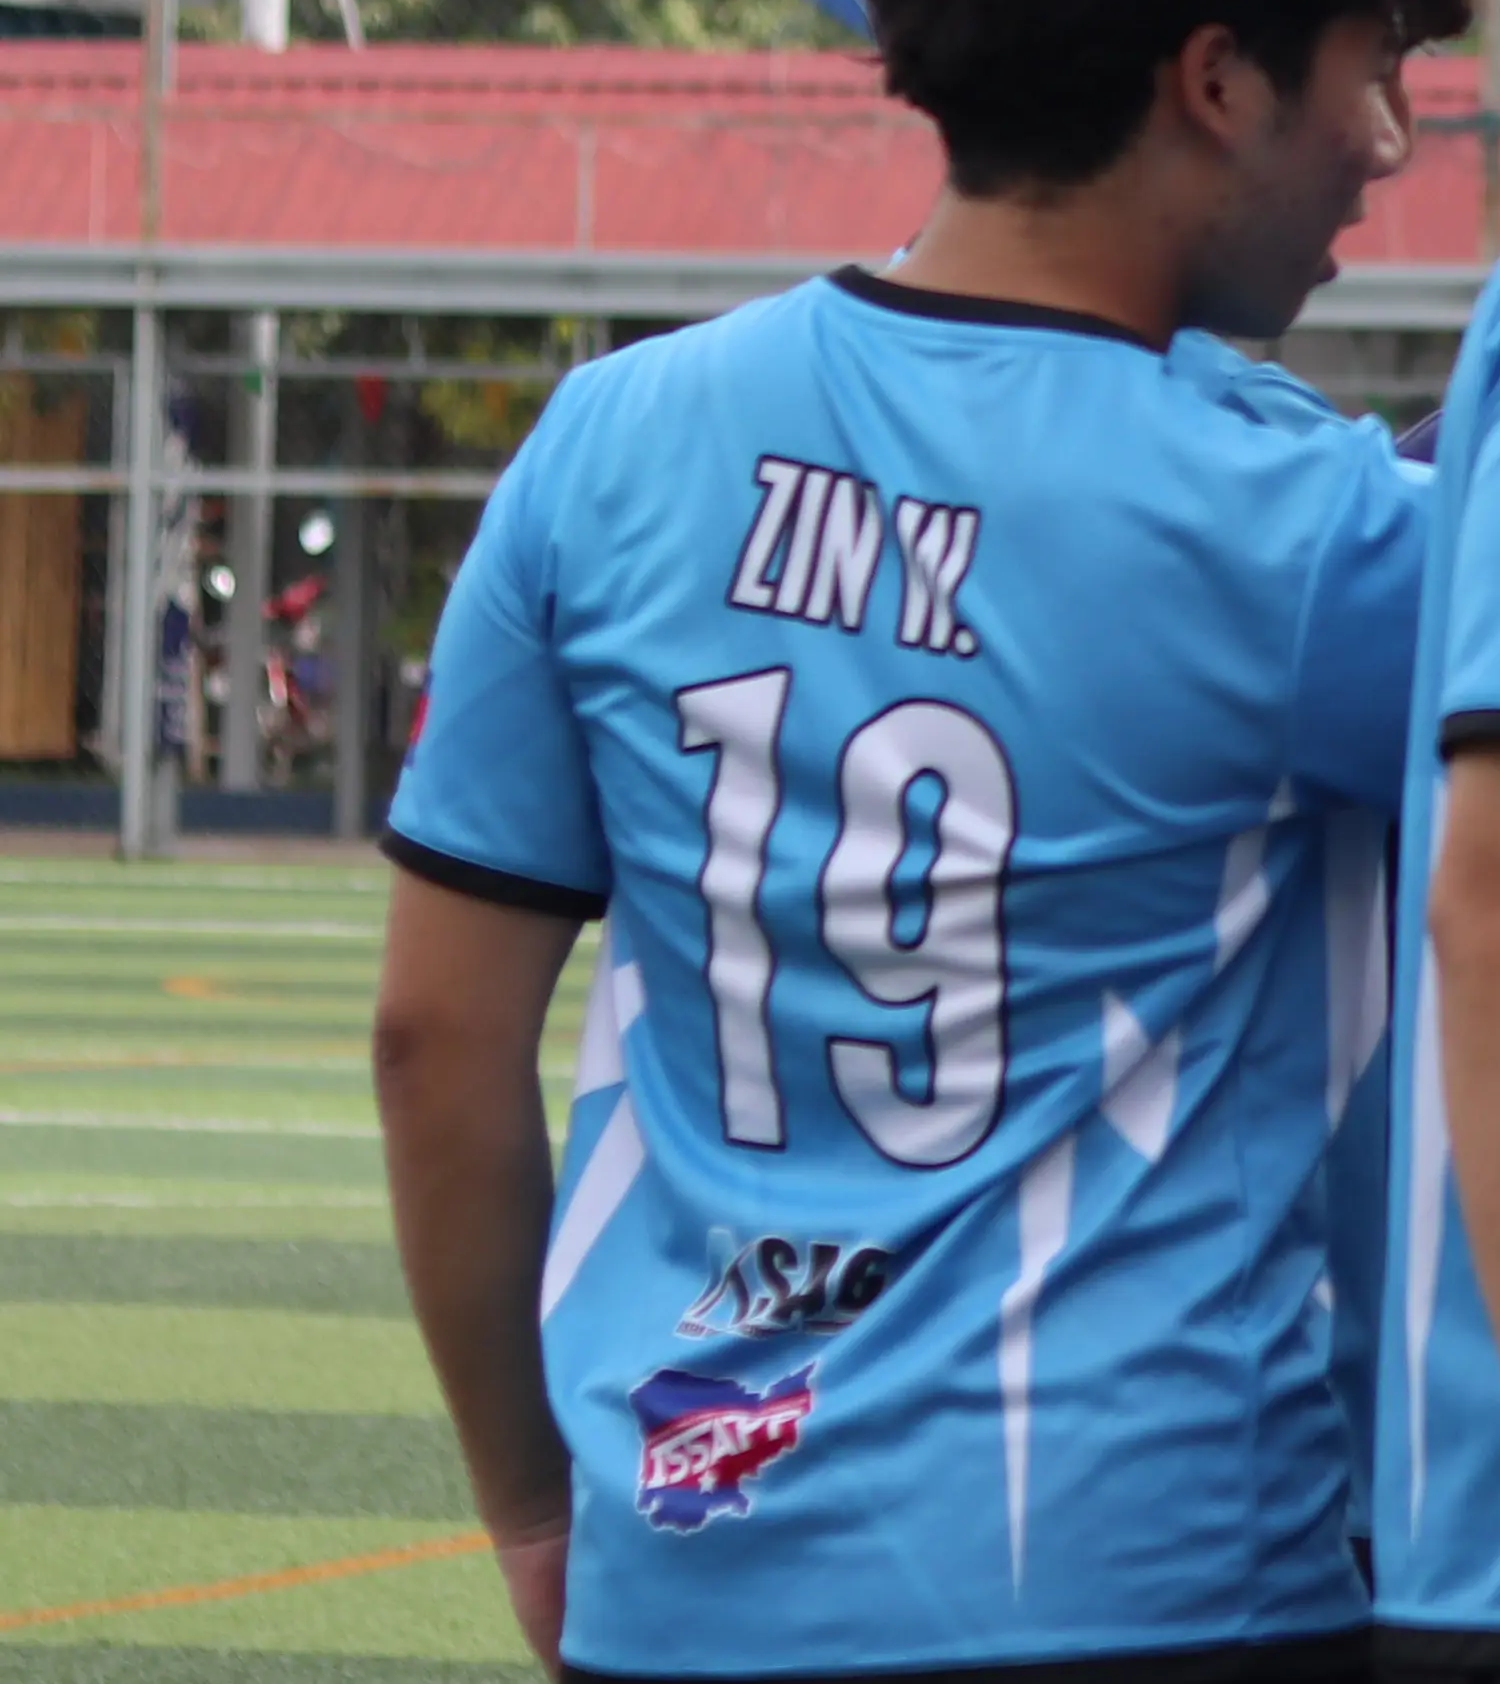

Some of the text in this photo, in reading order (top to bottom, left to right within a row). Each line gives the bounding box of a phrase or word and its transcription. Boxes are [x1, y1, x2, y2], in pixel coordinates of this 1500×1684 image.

[726, 454, 981, 659] ZIN W.
[679, 665, 1017, 1169] 19
